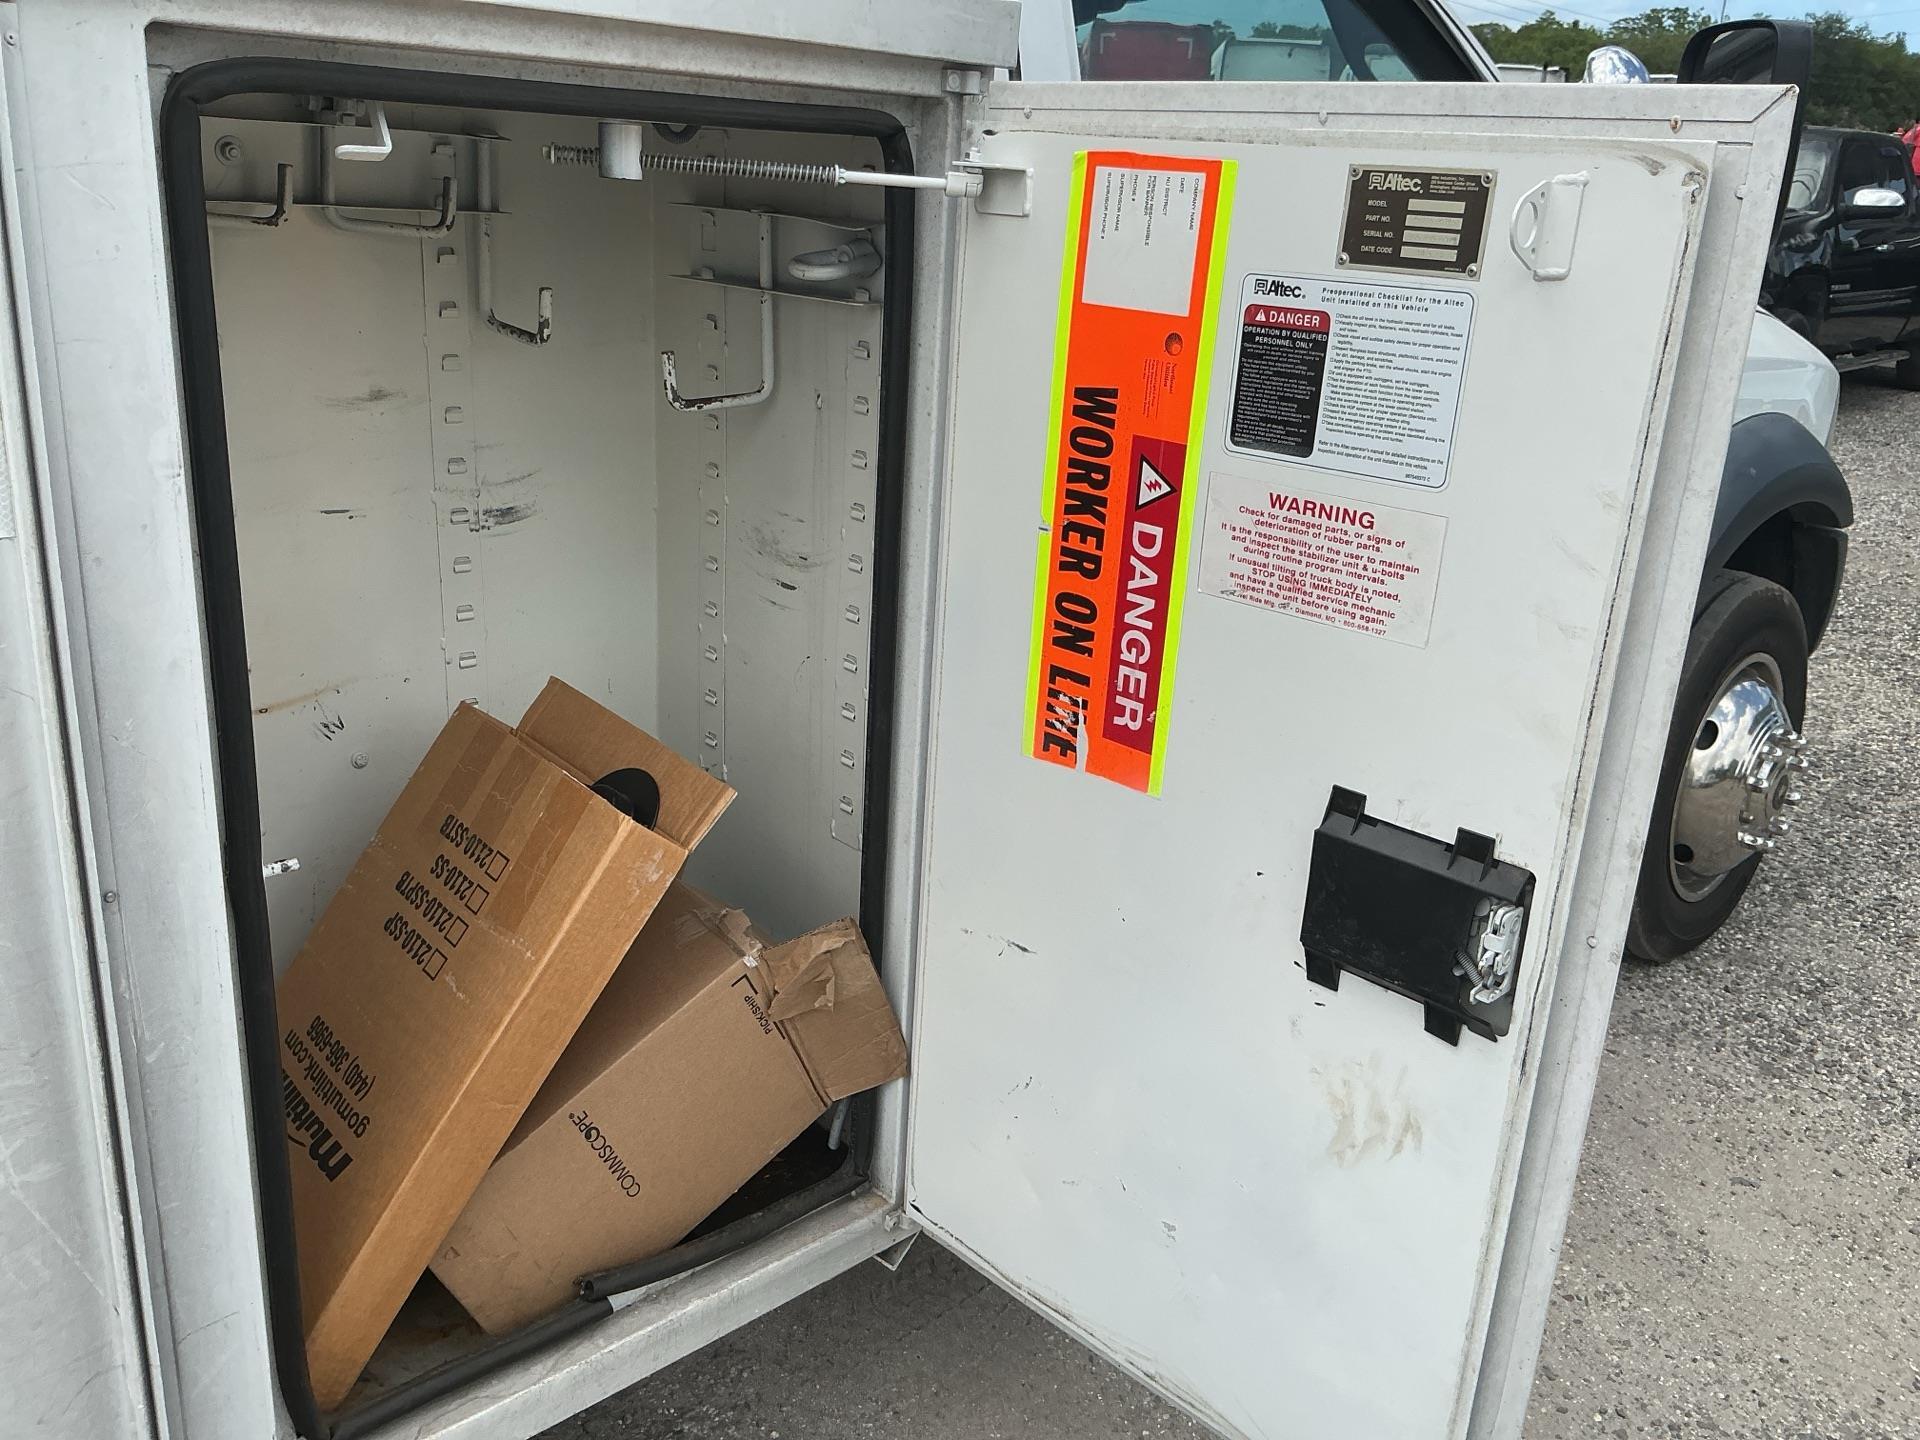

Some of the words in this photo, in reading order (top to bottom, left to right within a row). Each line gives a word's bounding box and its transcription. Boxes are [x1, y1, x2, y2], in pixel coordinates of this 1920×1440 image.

[1103, 172, 1111, 211] SUPERVISOR
[1116, 173, 1125, 212] SUPERVISOR
[1165, 176, 1170, 186] NU
[1191, 177, 1199, 210] COMPANY
[1367, 199, 1387, 207] MODEL
[1144, 203, 1153, 246] RESPONSIBLE
[1363, 229, 1382, 237] SERIAL
[1321, 295, 1335, 303] Unit
[1338, 297, 1369, 306] Installed
[1401, 303, 1428, 312] Vehicle
[1322, 287, 1374, 297] Preoperational
[1377, 292, 1412, 301] Checklist
[1444, 298, 1464, 306] Altec
[1243, 325, 1279, 335] OPERATION
[1291, 331, 1327, 341] QUALIFIED
[1269, 310, 1319, 327] DANGER
[1254, 335, 1293, 346] PERSONNEL
[1295, 340, 1312, 348] ONLY
[1058, 385, 1119, 582] WORKER
[1238, 505, 1265, 517] Check
[1267, 511, 1279, 520] for
[1282, 515, 1322, 530] damaged
[1324, 525, 1350, 537] parts,
[1366, 534, 1391, 545] signs
[1395, 540, 1405, 548] of
[1269, 492, 1374, 529] WARNING
[1239, 526, 1251, 535] the
[1254, 531, 1312, 550] responsibility
[1326, 546, 1340, 555] the
[1343, 551, 1364, 561] user
[1366, 555, 1375, 564] to
[1378, 559, 1419, 573] maintain
[1254, 518, 1309, 536] deterioration
[1311, 531, 1321, 539] of
[1323, 534, 1353, 546] rubber
[1356, 542, 1382, 552] parts.
[1231, 534, 1246, 543] and
[1249, 537, 1279, 550] inspect
[1282, 545, 1295, 554] the
[1298, 550, 1339, 564] stabilizer
[1341, 560, 1358, 569] unit
[1361, 563, 1368, 571] &
[1371, 567, 1404, 580] u-bolts
[1243, 545, 1269, 559] during
[1272, 553, 1302, 565] routine
[1305, 560, 1342, 574] program
[1345, 569, 1387, 585] intervals.
[1229, 571, 1244, 580] and
[1246, 574, 1266, 586] have
[1276, 583, 1313, 597] qualified
[1315, 593, 1348, 607] service
[1350, 603, 1395, 618] mechanic
[1237, 556, 1269, 569] unusual
[1272, 563, 1295, 577] tilting
[1309, 572, 1332, 584] truck
[1335, 578, 1358, 591] body
[1360, 585, 1368, 593] is
[1371, 589, 1400, 602] noted,
[1251, 567, 1275, 578] STOP
[1278, 573, 1306, 587] USING
[1309, 581, 1372, 603] IMMEDIATELY
[1052, 590, 1098, 658] ON
[1234, 580, 1263, 594] inspect
[1266, 589, 1279, 598] the
[1282, 594, 1298, 603] unit
[1300, 597, 1329, 610] before
[1331, 607, 1356, 619] using
[1359, 614, 1386, 626] again.
[1249, 595, 1262, 603] Ride
[1294, 607, 1321, 618] Diamond,
[1325, 614, 1335, 622] MO
[1112, 523, 1164, 733] DANGER
[439, 813, 496, 868] 2110-SSTB
[429, 853, 476, 903] 2110-SS
[394, 870, 455, 934] 2110-SSPTB
[382, 911, 432, 964] 2110-SSP
[743, 994, 772, 1035] PICK/SHIP
[306, 1014, 349, 1073] 366-6966
[284, 1030, 371, 1138] gomultilink.com
[340, 1055, 376, 1102] (440)
